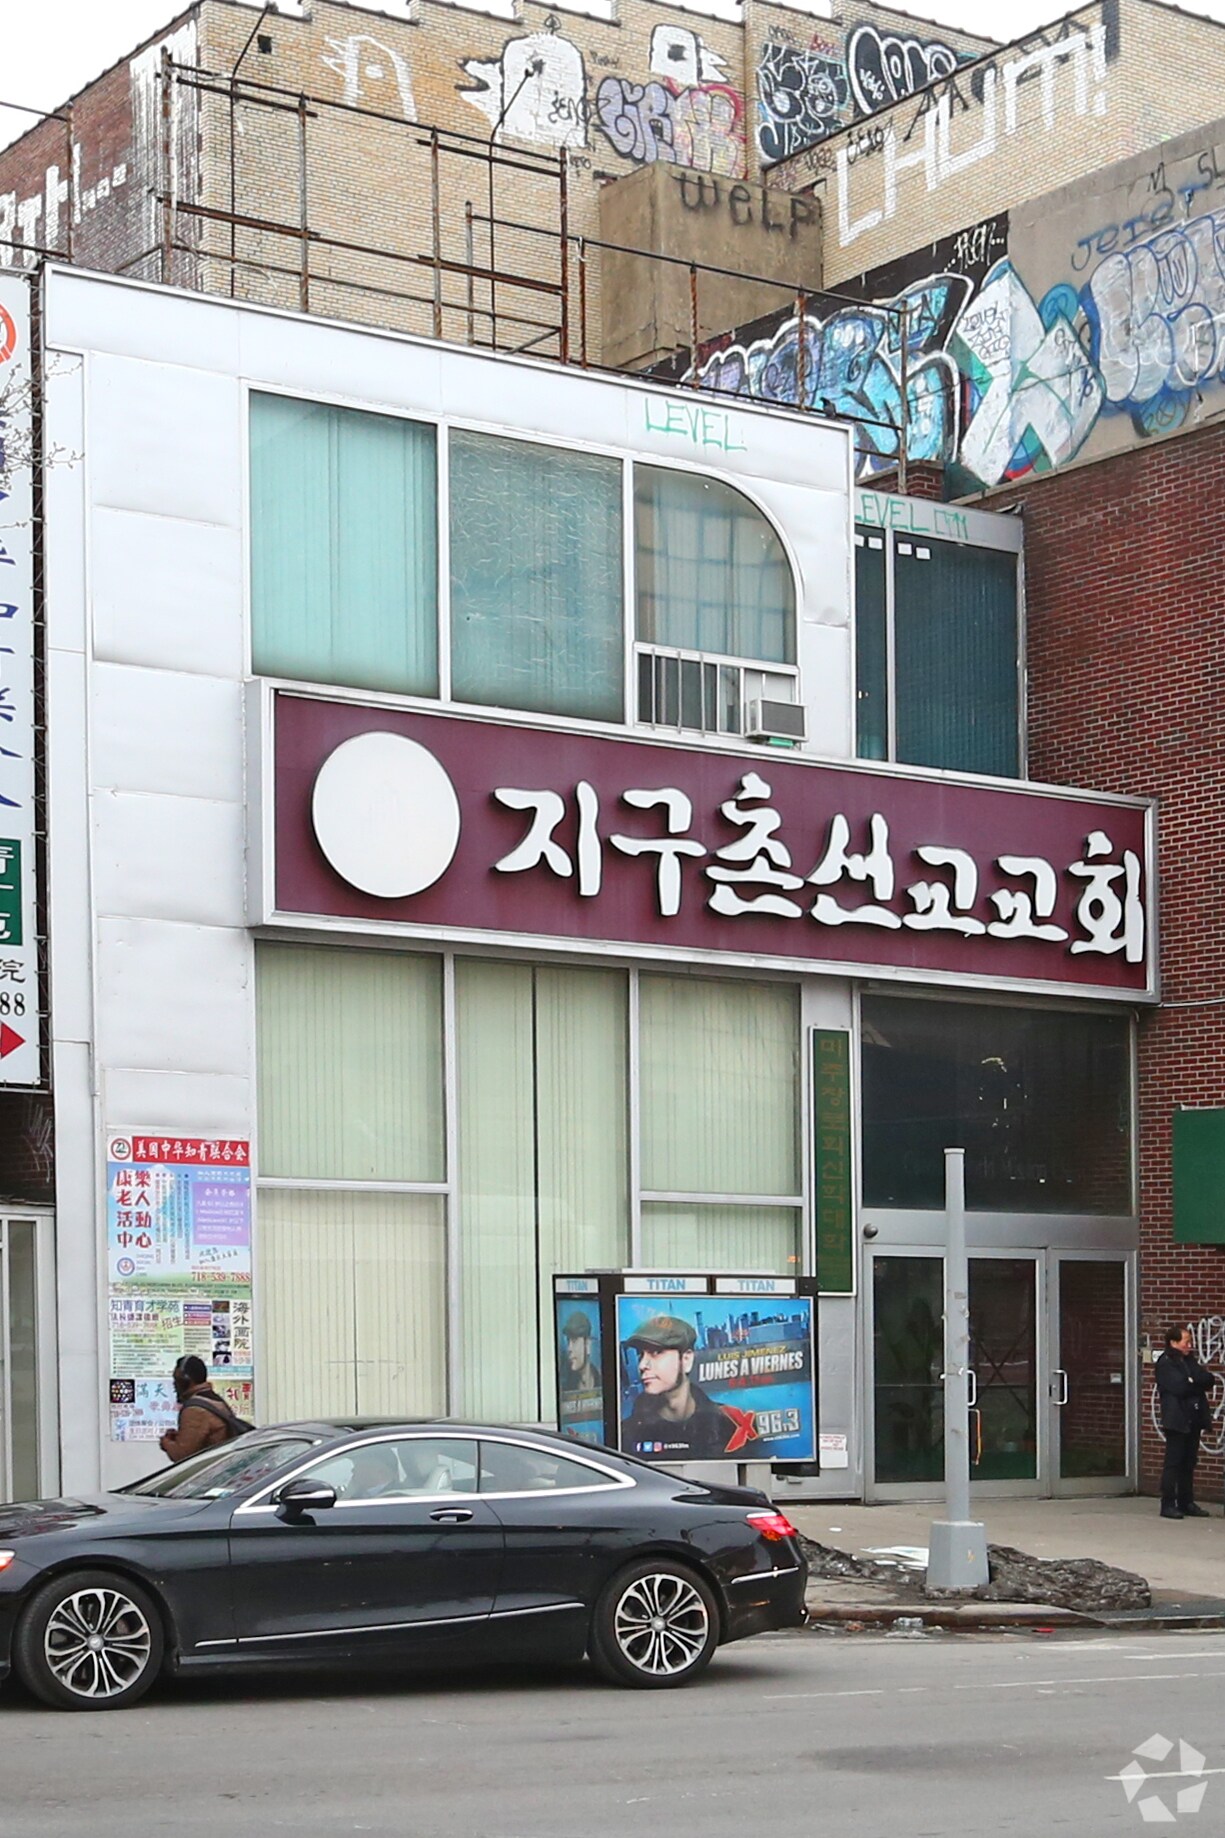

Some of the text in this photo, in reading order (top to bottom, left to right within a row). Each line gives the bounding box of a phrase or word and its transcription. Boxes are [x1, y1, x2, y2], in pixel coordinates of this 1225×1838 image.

[645, 398, 747, 451] LEVEL
[566, 1280, 588, 1291] TITAN
[646, 1279, 686, 1290] TITAN
[737, 1280, 775, 1291] TITAN
[699, 1359, 738, 1382] LUNES
[740, 1358, 749, 1377] A
[750, 1351, 803, 1375] VIERNES
